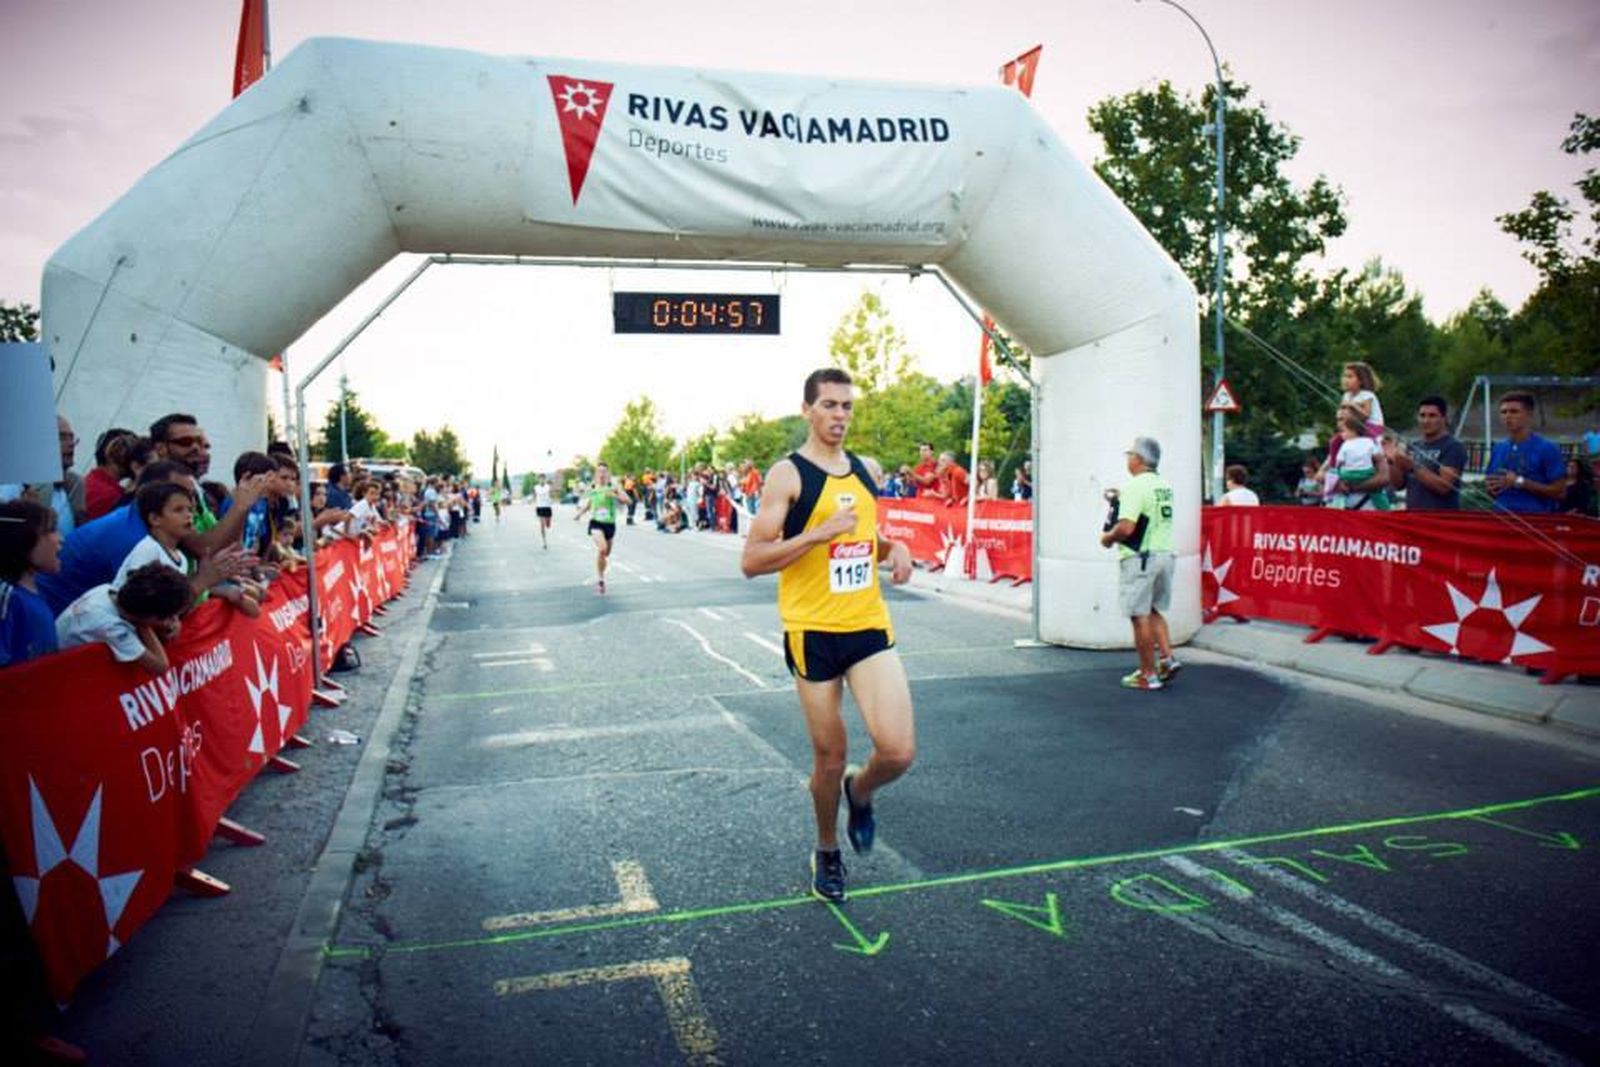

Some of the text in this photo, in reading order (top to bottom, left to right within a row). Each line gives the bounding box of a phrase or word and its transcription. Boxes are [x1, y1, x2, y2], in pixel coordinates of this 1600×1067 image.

[628, 92, 950, 144] RIVAS VACIAMADRID
[628, 128, 729, 163] Deportes
[653, 300, 764, 327] 0:04:57
[1253, 532, 1422, 565] RIVAS VACIAMADRID
[834, 561, 869, 587] 1197
[1251, 556, 1341, 588] Deportes
